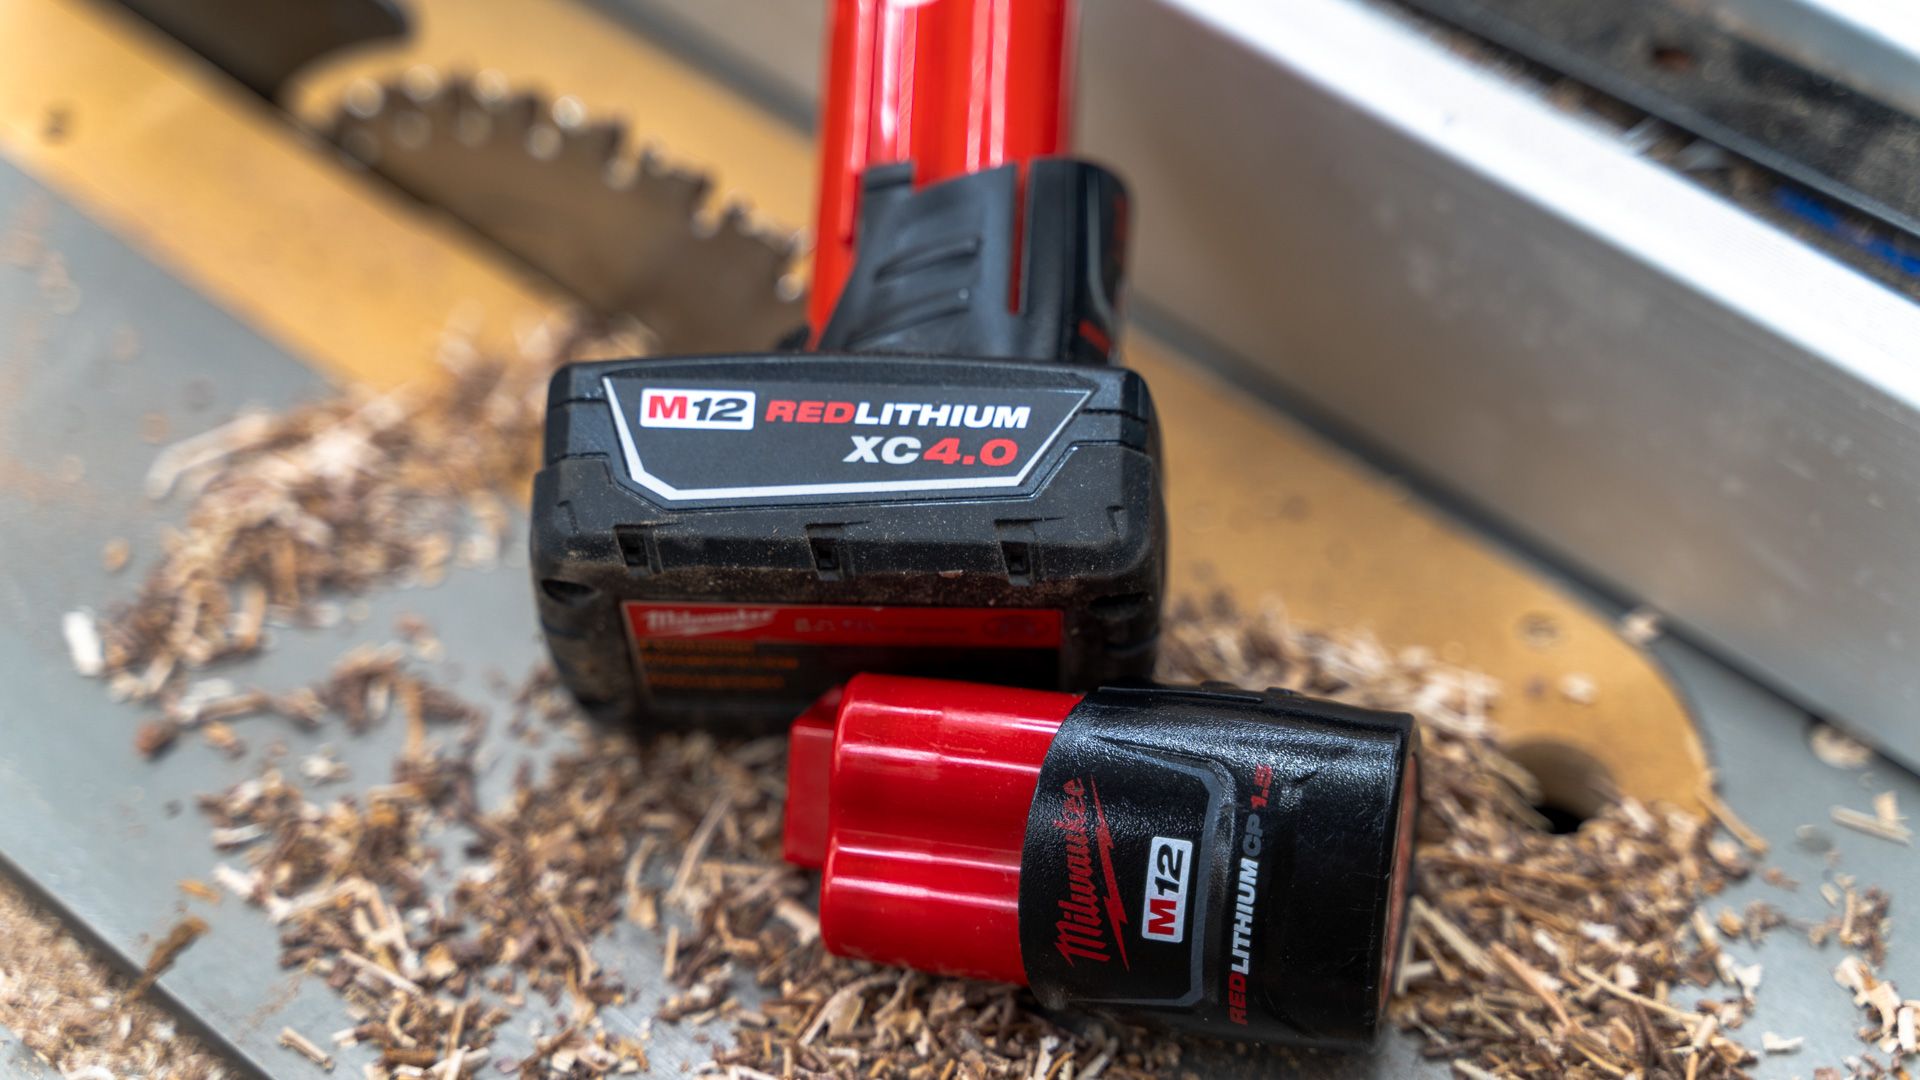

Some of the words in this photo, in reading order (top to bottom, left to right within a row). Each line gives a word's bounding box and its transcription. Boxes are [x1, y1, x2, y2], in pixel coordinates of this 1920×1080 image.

[648, 394, 748, 423] M12
[765, 400, 1030, 429] REDLITHIUM
[1053, 776, 1112, 969] Milwaukee
[1147, 843, 1184, 936] M12
[1228, 860, 1259, 1026] REDLITHIUM
